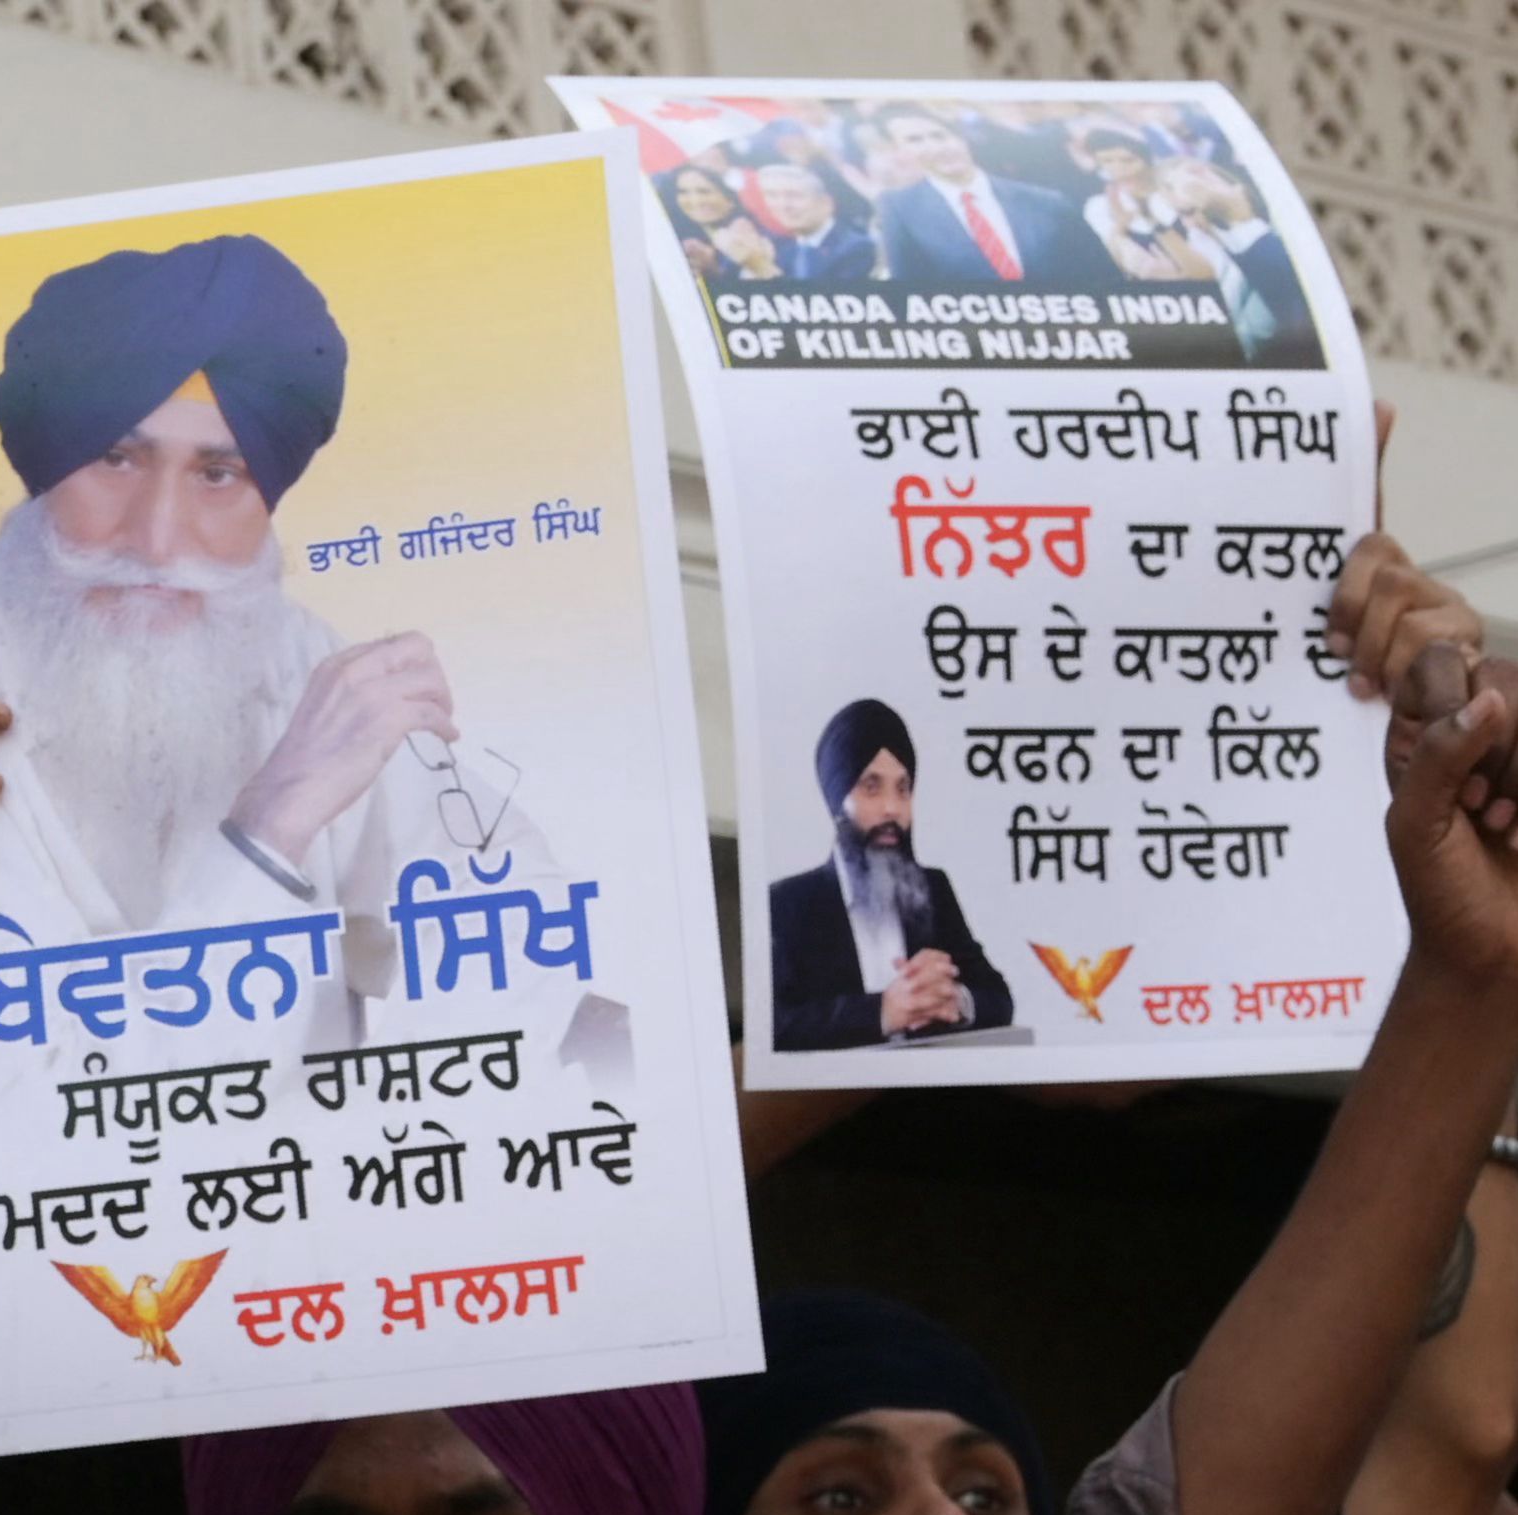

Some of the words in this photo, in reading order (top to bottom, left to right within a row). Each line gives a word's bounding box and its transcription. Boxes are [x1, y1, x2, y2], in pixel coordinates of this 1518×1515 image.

[715, 295, 896, 325] CANADA
[905, 295, 1100, 326] ACCUSES
[1110, 296, 1228, 326] INDIA
[726, 331, 787, 360] OF
[798, 331, 972, 360] KILLING
[983, 331, 1132, 360] NIJJAR
[851, 388, 980, 461] ਭਾਈ
[1008, 388, 1198, 461] ਹਰਦੀਪ
[1228, 387, 1338, 463] ਸਿੰਘ
[307, 523, 381, 572] ਭਾਈ
[400, 514, 516, 562] ਗਜਿੰਦਰ
[533, 499, 602, 547] ਸਿੰਘ
[891, 475, 1090, 579] ਨਿੱਝਰ
[1129, 524, 1189, 579] ਦਾ
[1216, 524, 1345, 581] ਕਤਲ
[1045, 606, 1085, 681] ਦੇ
[1114, 611, 1277, 682] ਕਾਤਲਾਂ
[966, 728, 1094, 780] ਕਫਨ
[1123, 728, 1181, 779] ਦਾ
[1208, 706, 1320, 780] ਕਿੱਲ
[1009, 806, 1110, 881] ਸਿੱਧ
[1137, 802, 1288, 879] ਹੋਵੇਗਾ
[390, 850, 598, 1001] ਸਿੱਖ
[1143, 984, 1211, 1025] ਦਲ
[303, 1030, 522, 1110] ਰਾਸ਼ਟਰ
[183, 1139, 311, 1231] ਲਈ
[344, 1120, 466, 1209] ਅੱਗੇ
[501, 1101, 637, 1192] ਆਵੇ
[235, 1284, 344, 1348] ਦਲ
[377, 1255, 584, 1337] ਖ਼ਾਲਸਾ
